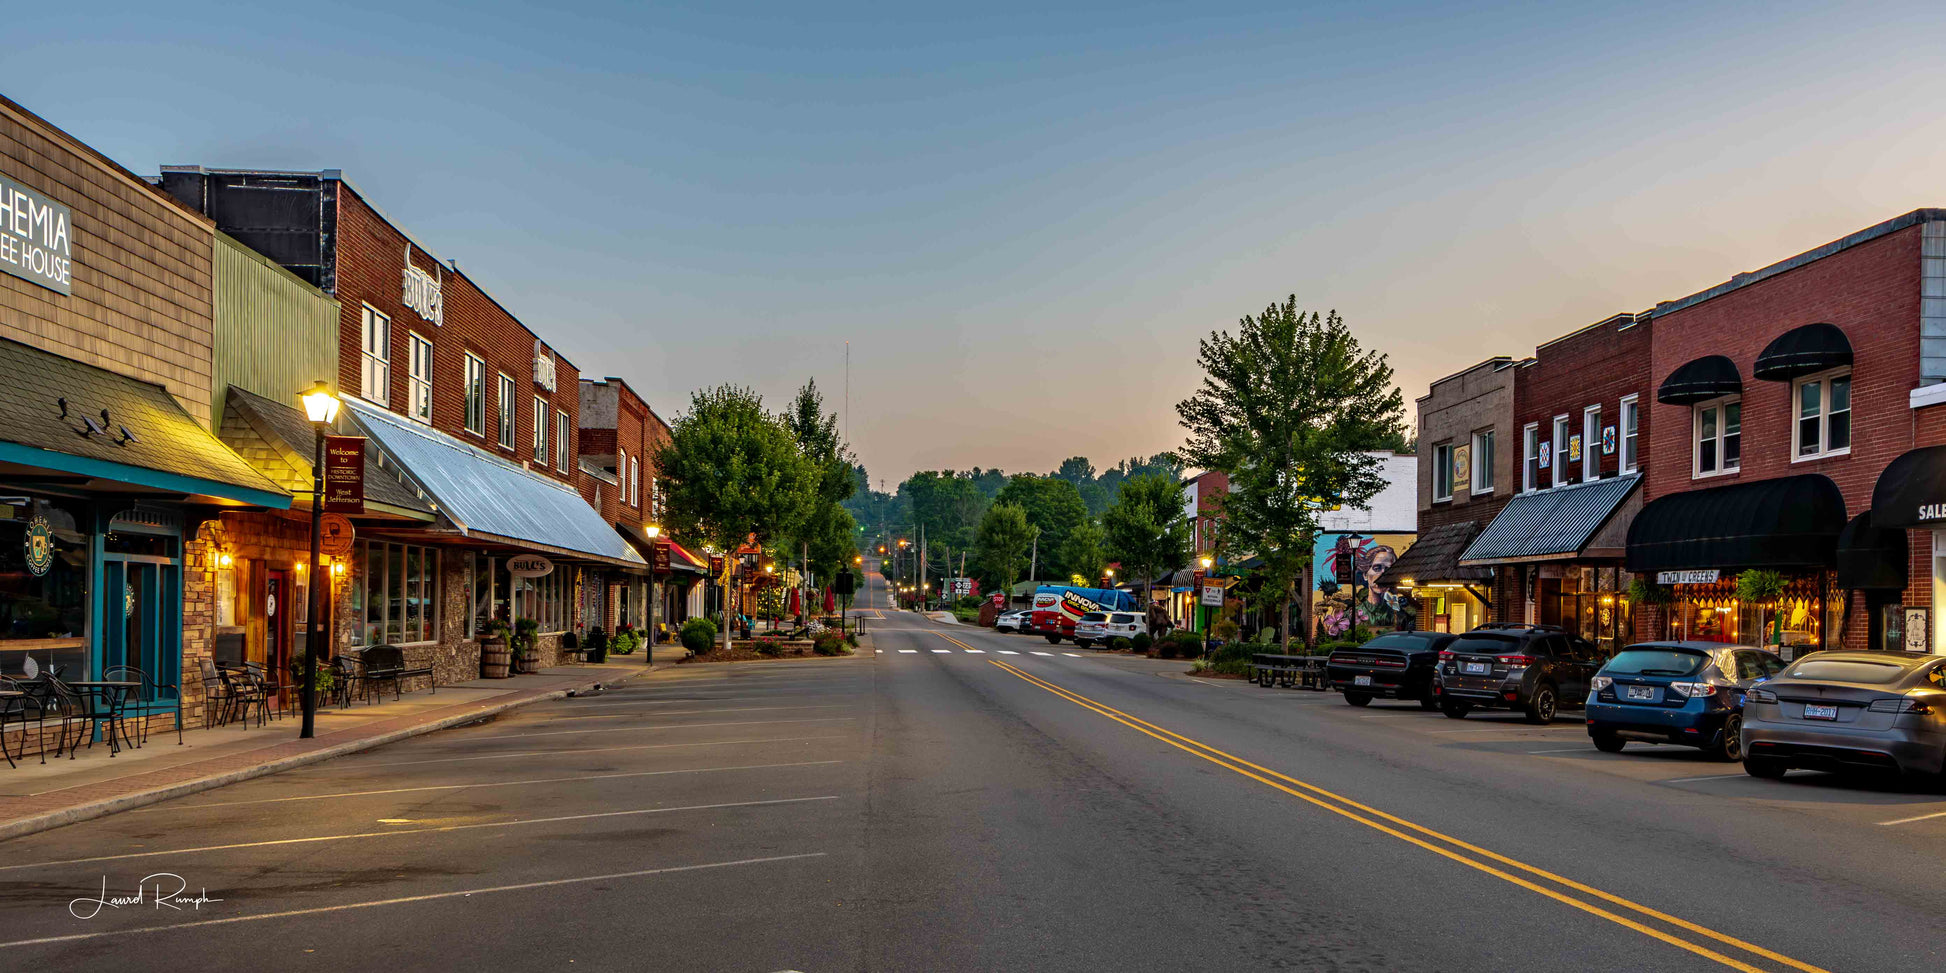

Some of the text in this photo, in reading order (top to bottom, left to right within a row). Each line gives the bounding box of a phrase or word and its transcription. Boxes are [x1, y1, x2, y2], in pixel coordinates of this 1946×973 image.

[0, 183, 70, 256] HEMIA
[22, 241, 70, 286] HOUSE
[329, 447, 359, 456] Welcome
[26, 515, 53, 537] BOHEMIA
[26, 554, 40, 574] COFFEE
[513, 560, 546, 571] BULL'S
[1662, 570, 1714, 583] TWIN CREEKS
[1064, 590, 1101, 611] INNOVA
